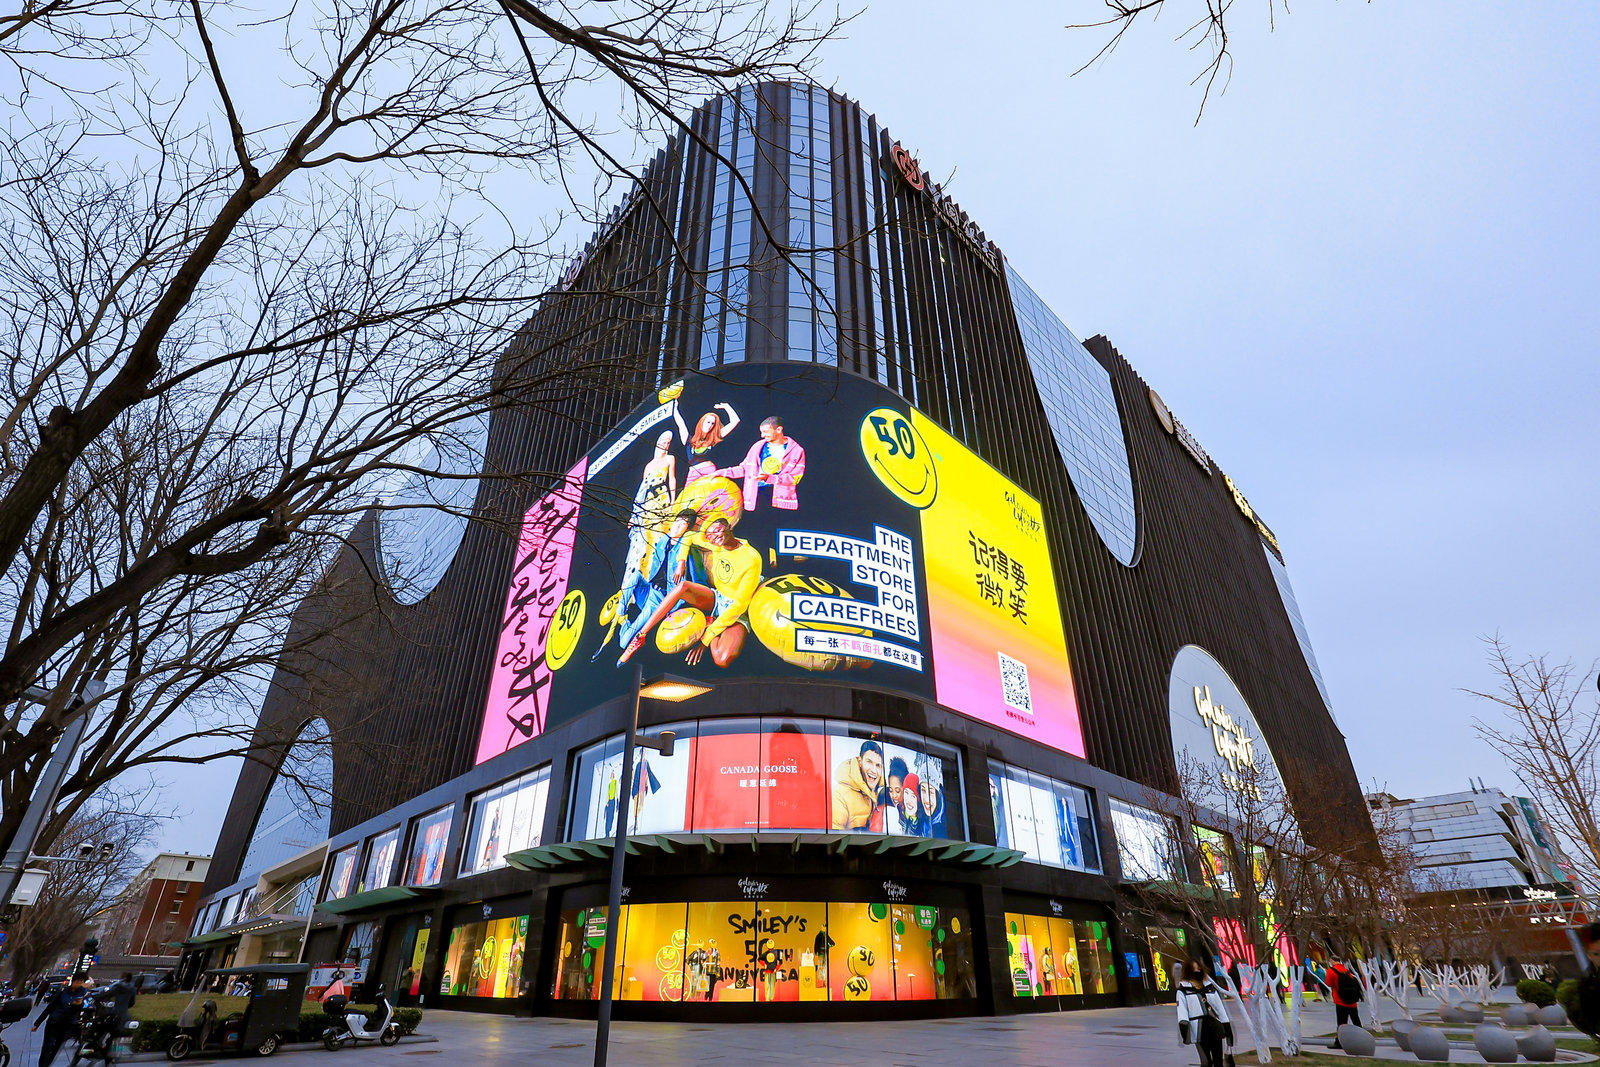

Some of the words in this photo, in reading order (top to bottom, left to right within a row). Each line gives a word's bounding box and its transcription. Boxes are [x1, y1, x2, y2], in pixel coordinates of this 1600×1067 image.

[640, 406, 669, 431] SMILEY
[869, 416, 915, 460] 50
[784, 535, 911, 573] DEPARTMENT
[879, 530, 910, 555] THE
[856, 564, 913, 594] STORE
[968, 531, 1028, 593] 记得要
[558, 594, 582, 631] 50
[882, 591, 915, 616] FOR
[976, 572, 1028, 626] 微笑
[799, 599, 917, 637] CAREFREES
[720, 765, 760, 775] CANADA
[763, 764, 798, 774] GOOSE
